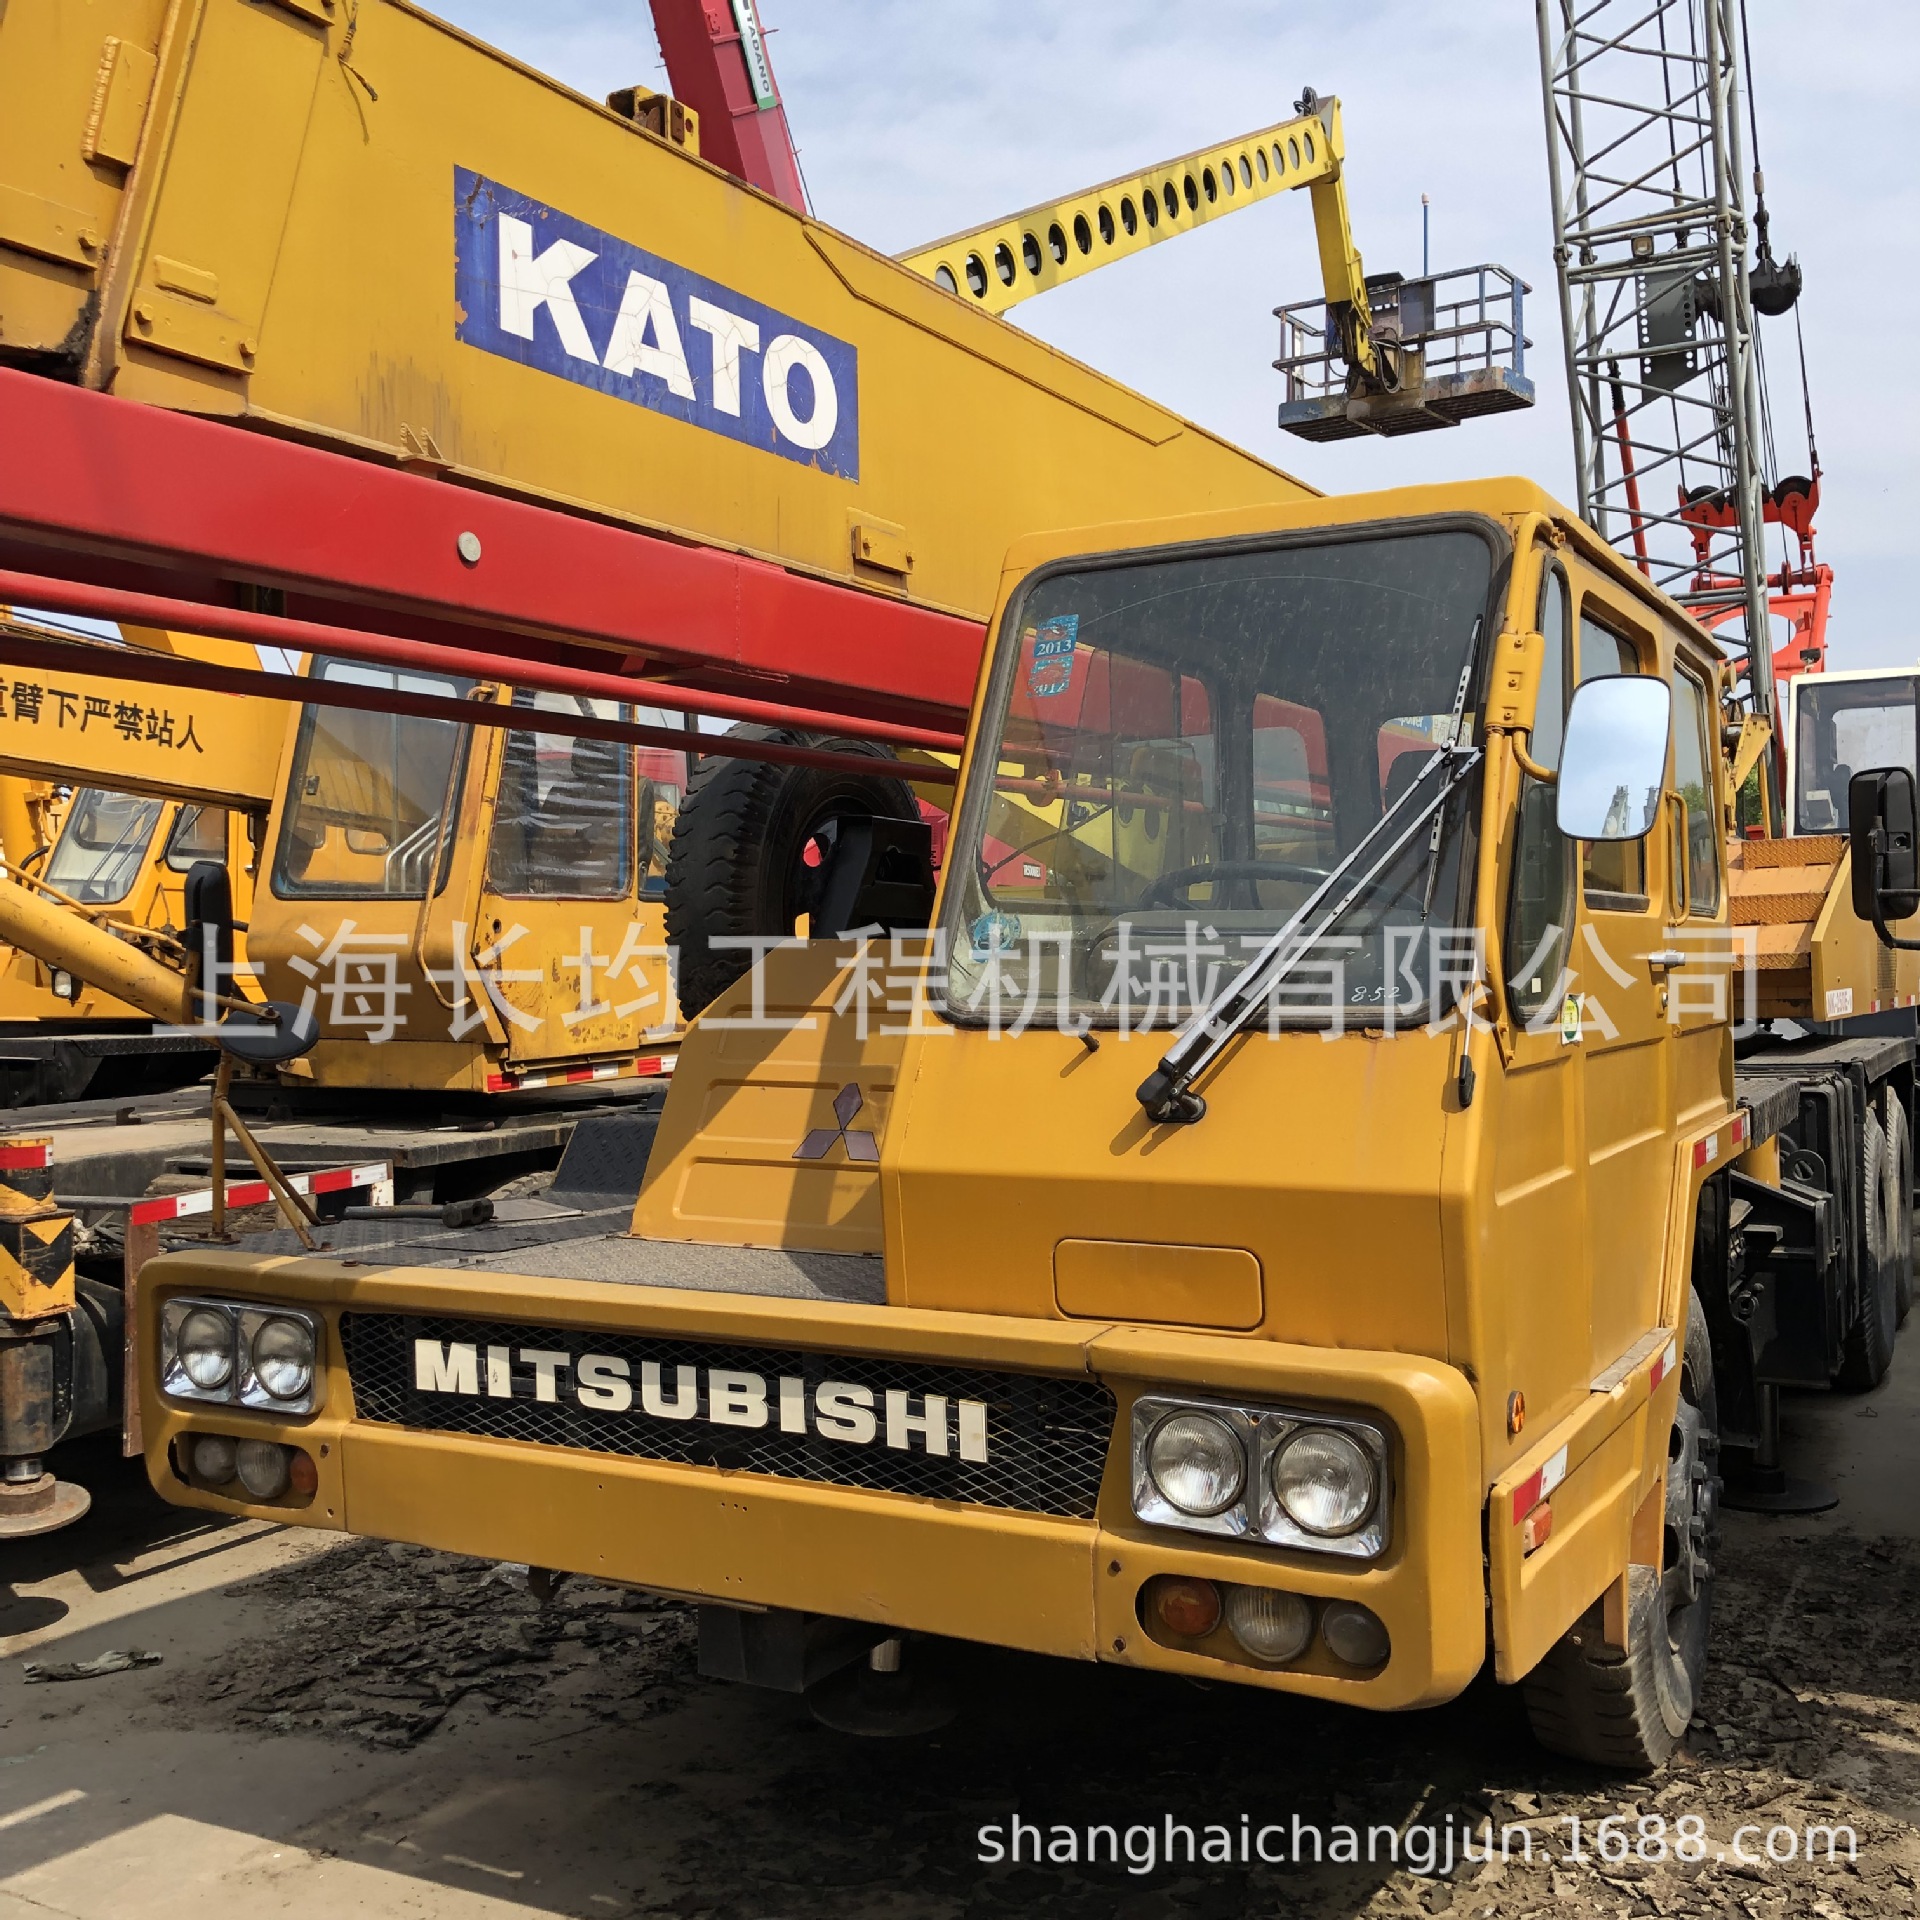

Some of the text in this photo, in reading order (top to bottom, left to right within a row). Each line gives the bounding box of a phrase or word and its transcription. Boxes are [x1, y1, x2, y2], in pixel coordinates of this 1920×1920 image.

[747, 13, 770, 93] TADANO
[498, 211, 840, 451] KATO
[1036, 639, 1072, 656] 2013
[0, 677, 204, 753] 臂下严禁站人
[414, 1338, 989, 1463] MITSUBISHI
